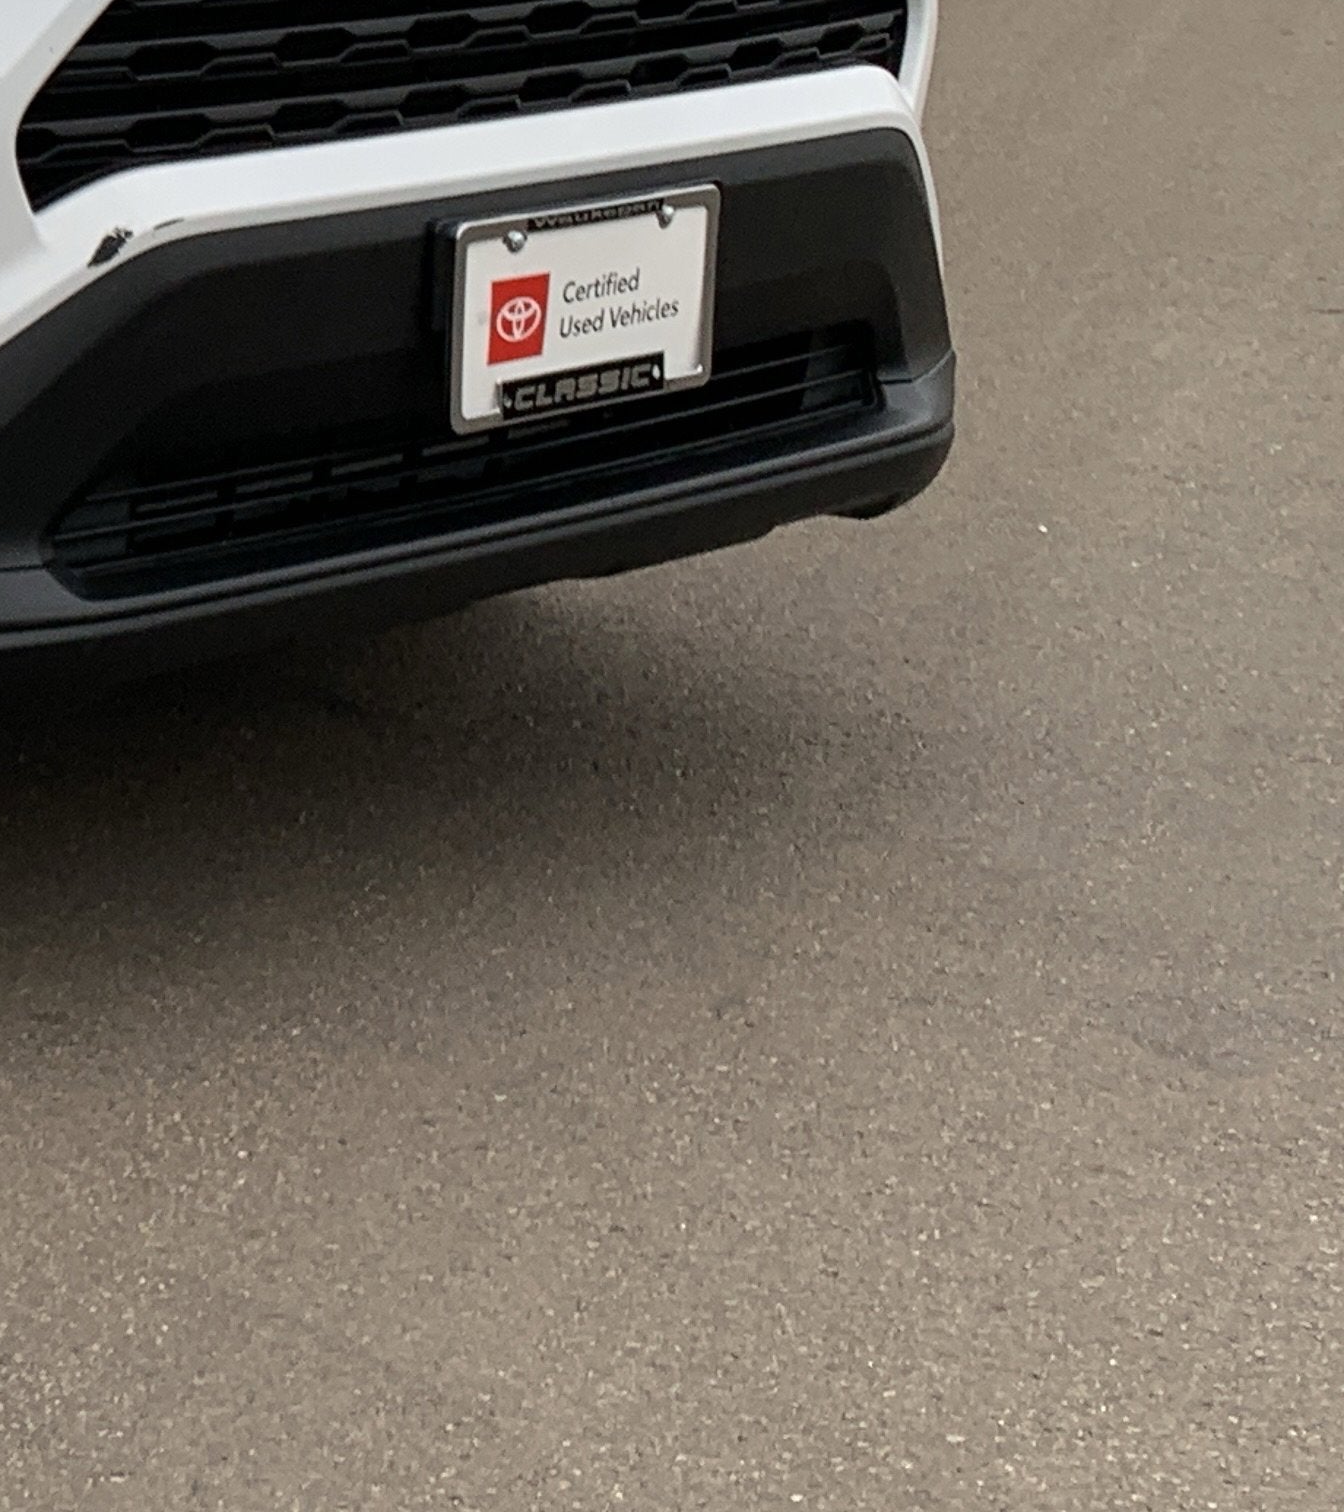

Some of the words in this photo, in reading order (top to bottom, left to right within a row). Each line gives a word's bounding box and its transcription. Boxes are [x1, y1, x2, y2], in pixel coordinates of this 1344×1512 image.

[562, 267, 641, 304] Certified
[559, 307, 604, 339] Used
[608, 297, 680, 329] Vehicles
[513, 363, 652, 411] CLASSIC
